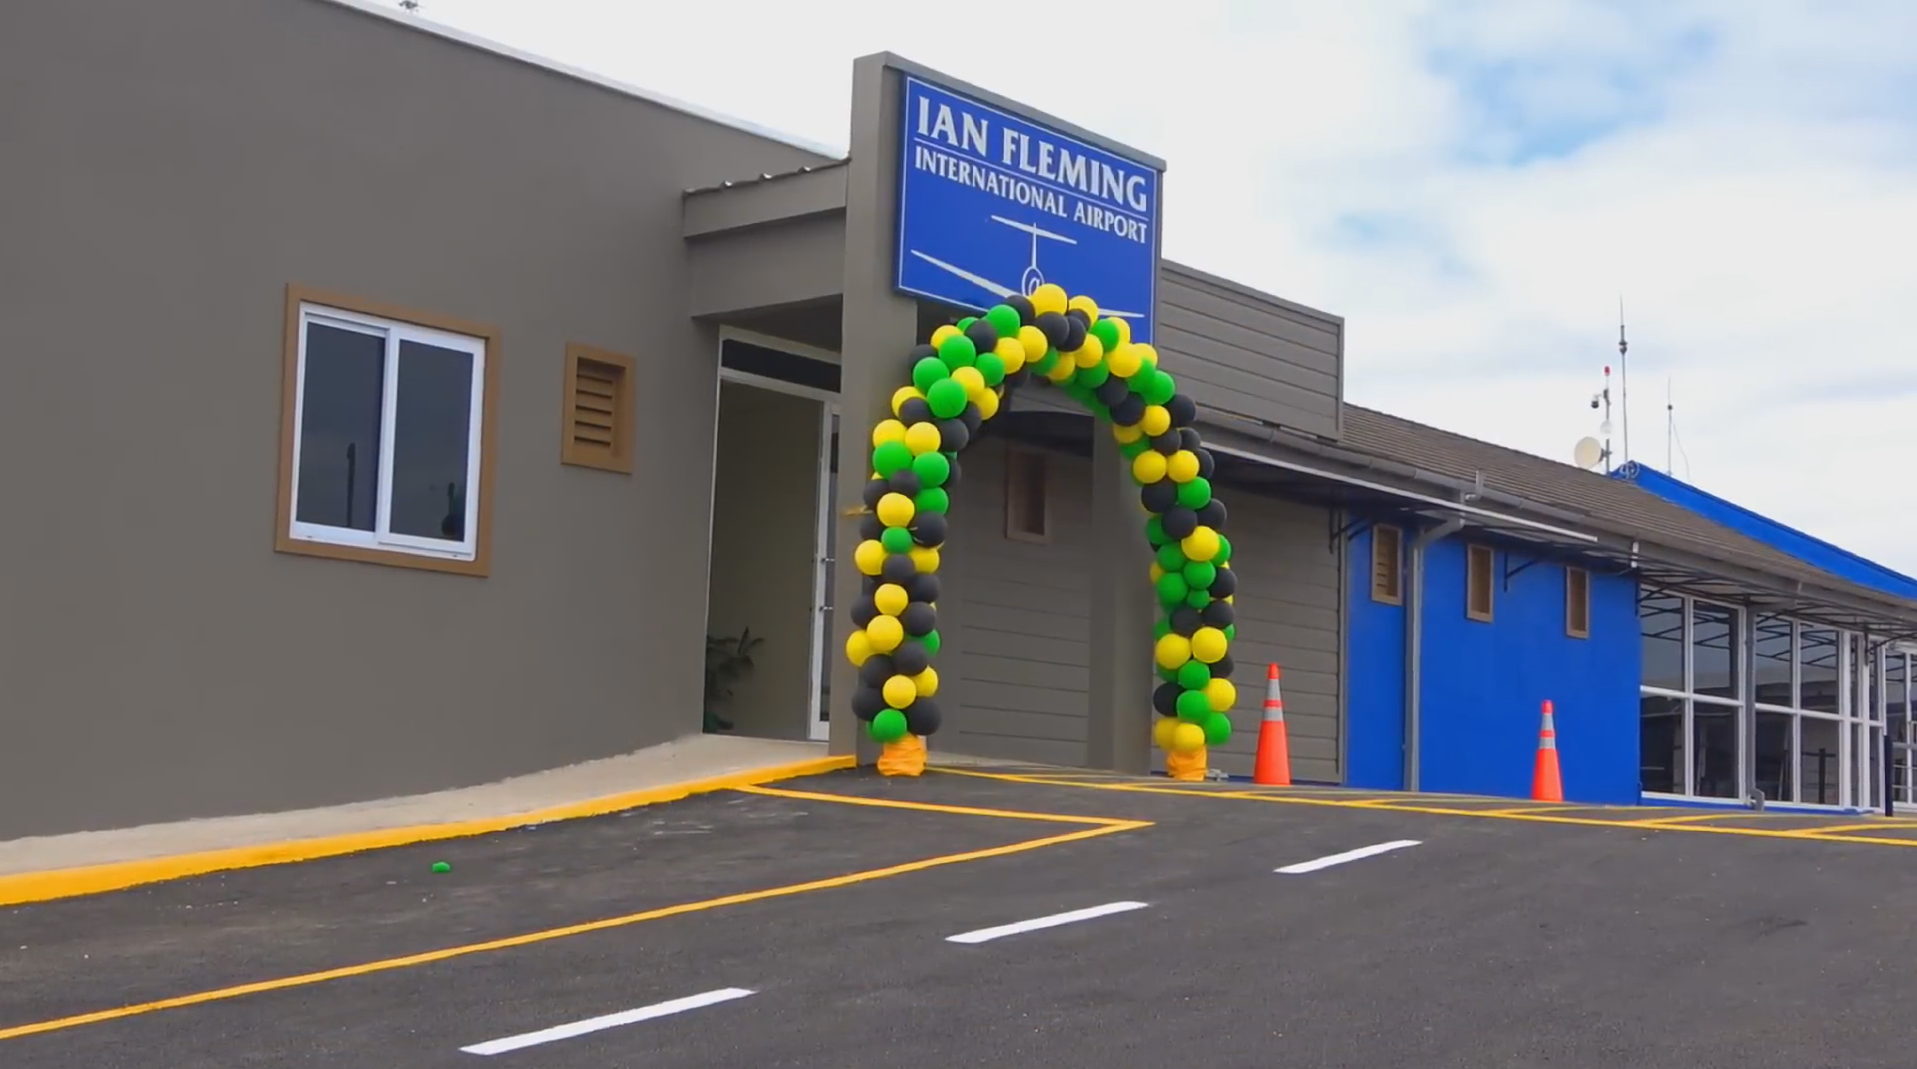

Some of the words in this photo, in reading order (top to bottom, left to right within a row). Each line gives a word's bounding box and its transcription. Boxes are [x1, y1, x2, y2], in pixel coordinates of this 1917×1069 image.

[916, 146, 1067, 217] INTERNATIONAL
[1074, 202, 1148, 243] AIRPORT
[918, 96, 988, 156] IAN
[1003, 127, 1147, 212] FLEMING
